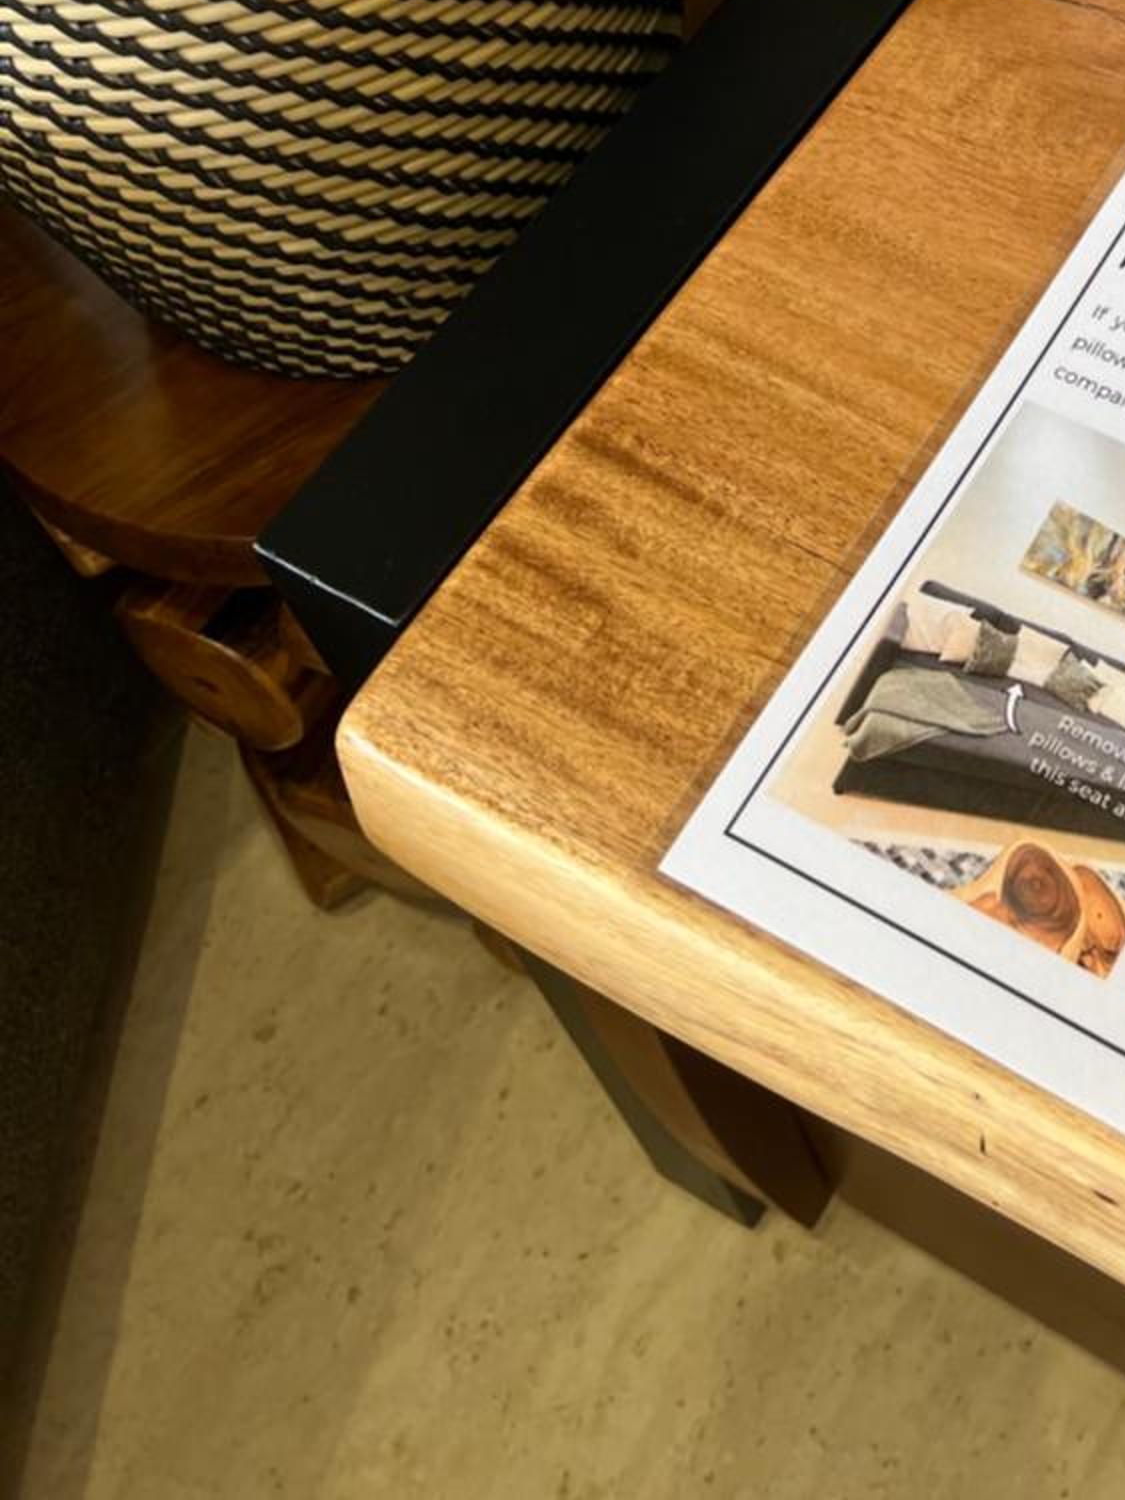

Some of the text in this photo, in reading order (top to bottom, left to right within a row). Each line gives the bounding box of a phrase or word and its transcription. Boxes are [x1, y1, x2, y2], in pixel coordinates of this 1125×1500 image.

[1091, 305, 1109, 322] If
[1027, 732, 1098, 774] pillows
[1100, 766, 1115, 782] &
[1029, 757, 1067, 787] this
[1067, 779, 1111, 809] seat
